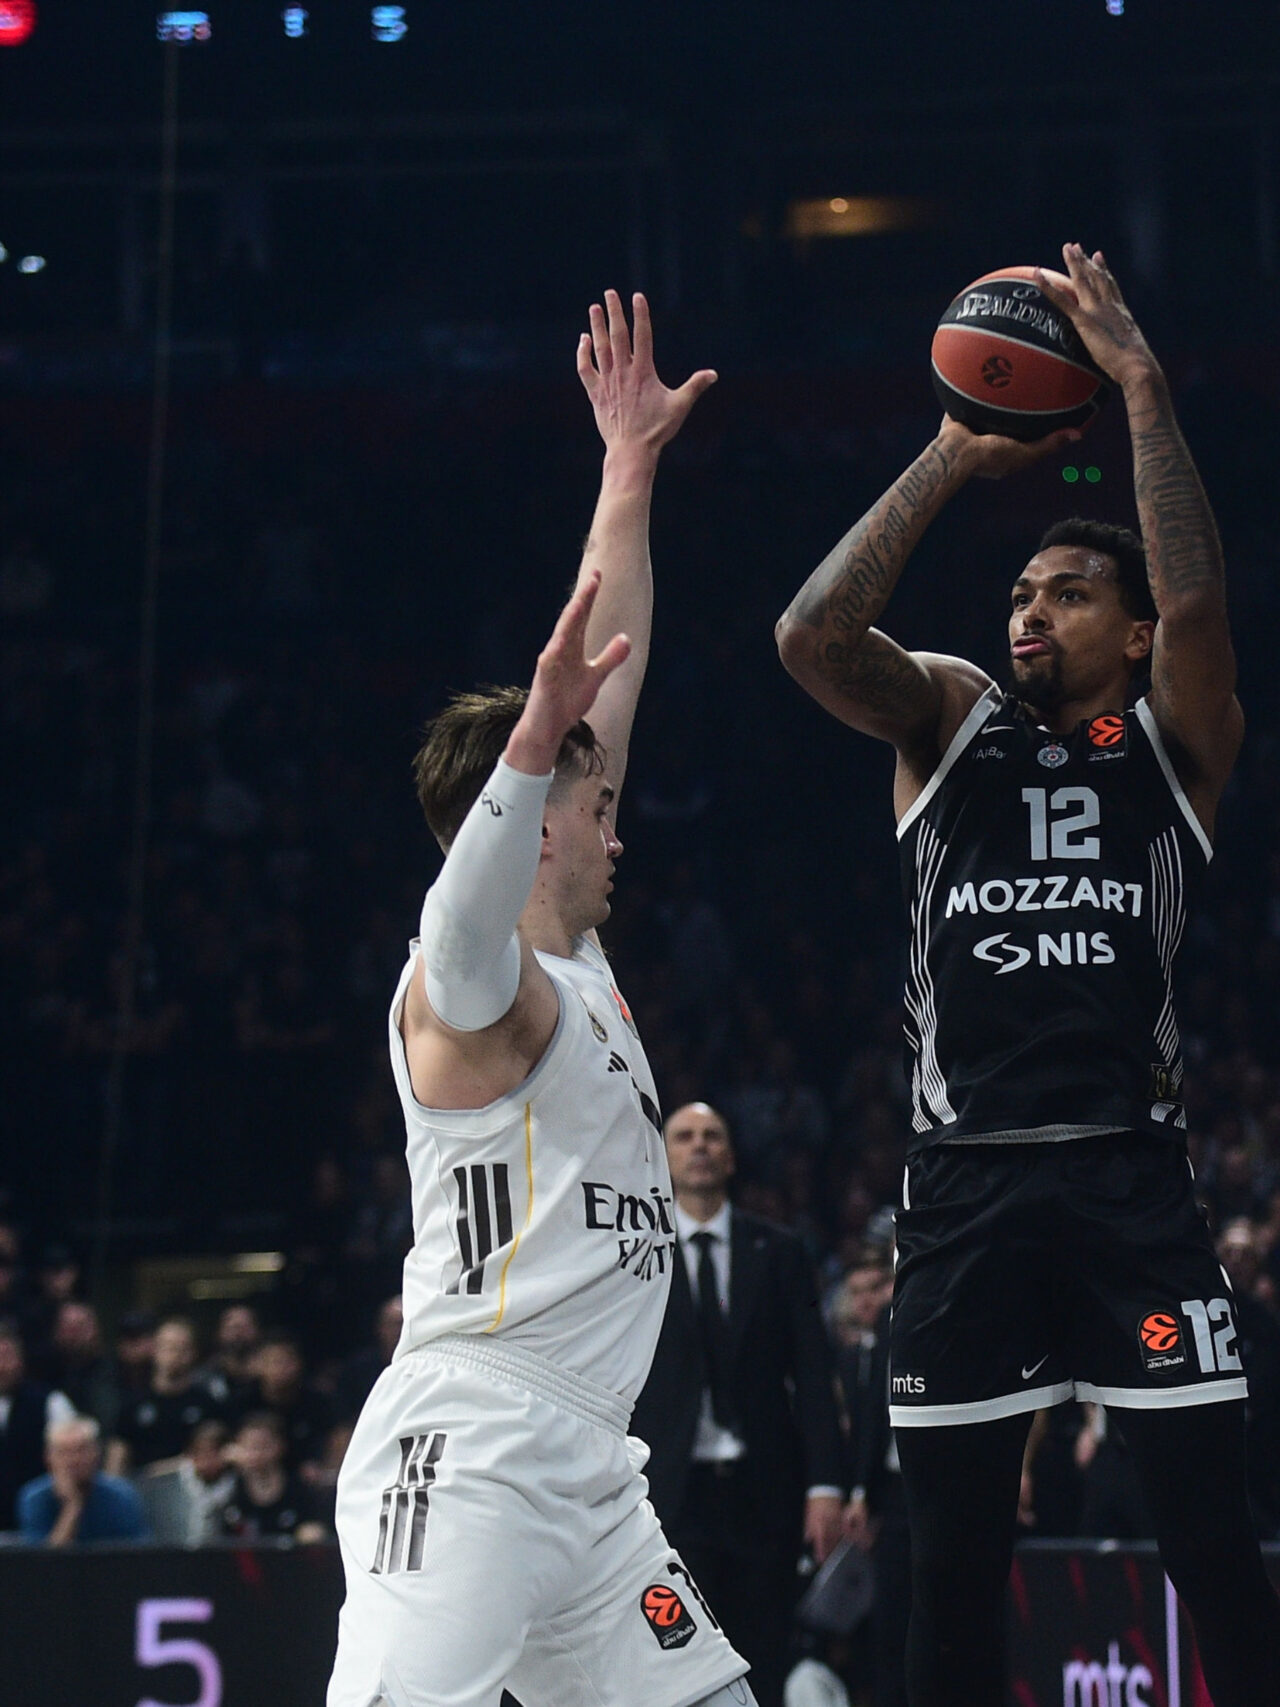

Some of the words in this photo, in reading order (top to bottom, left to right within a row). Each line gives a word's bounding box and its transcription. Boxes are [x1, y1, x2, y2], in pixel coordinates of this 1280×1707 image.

[1022, 787, 1099, 860] 12
[945, 876, 1143, 918] MOZZART
[1037, 932, 1115, 966] NIS
[1180, 1298, 1243, 1374] 12
[892, 1374, 925, 1393] mts
[134, 1598, 224, 1707] 5
[1062, 1640, 1153, 1707] mts
